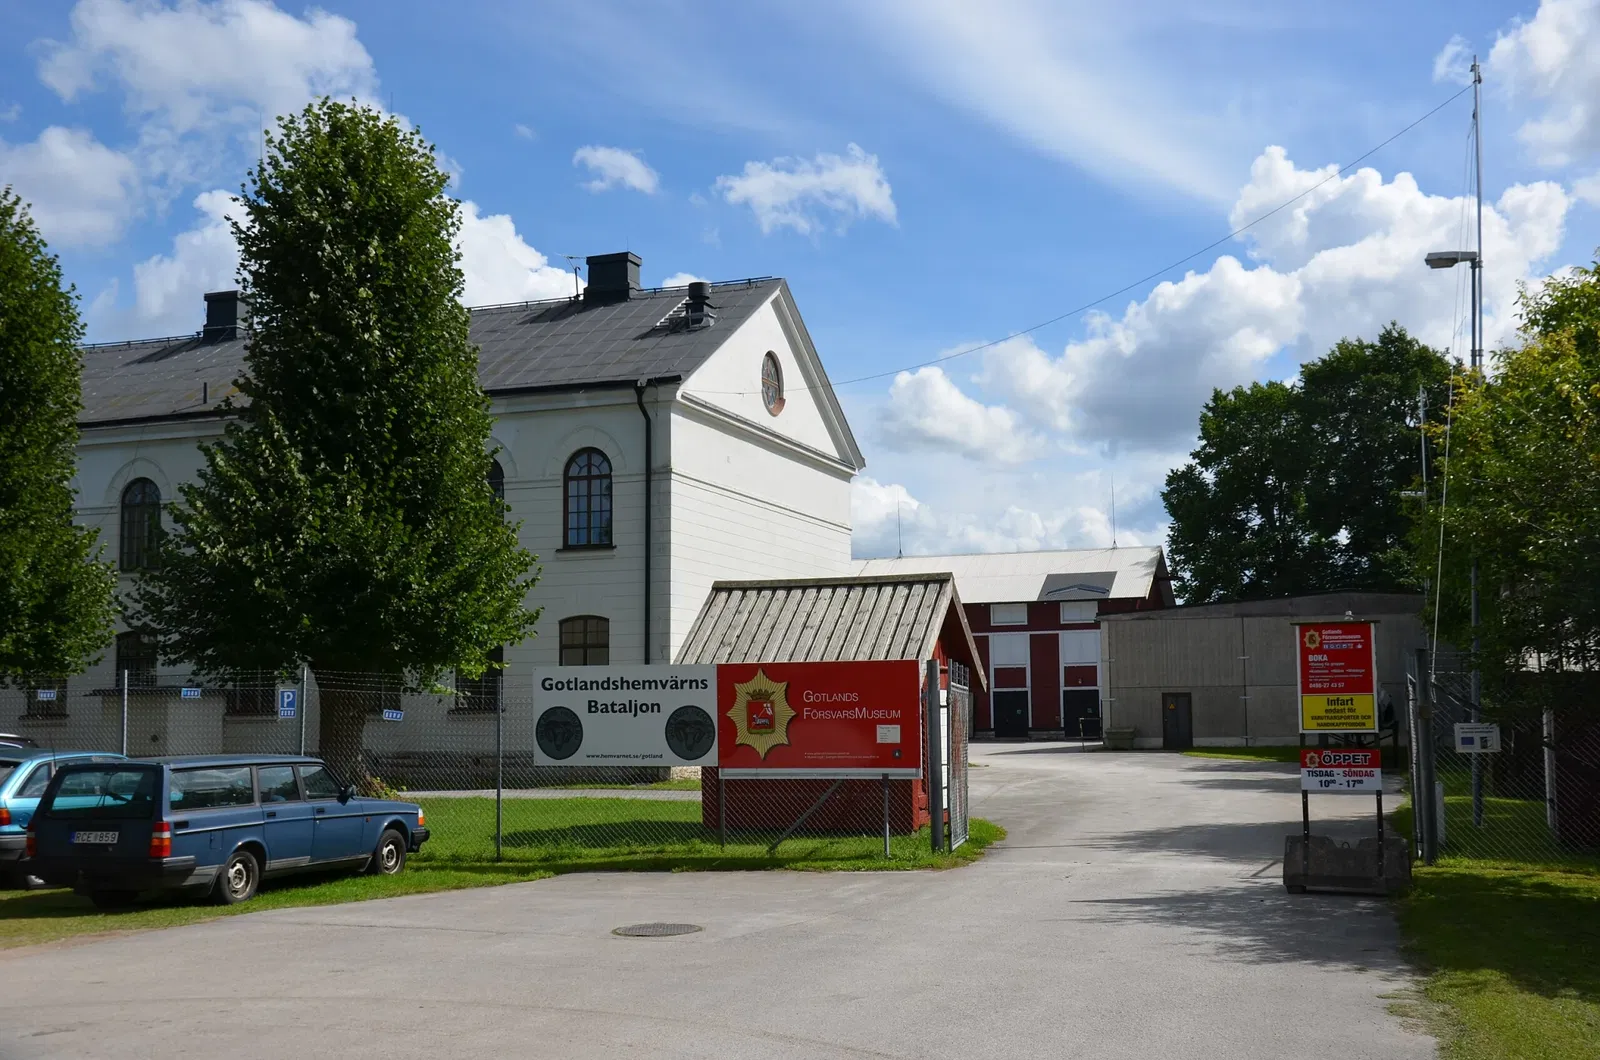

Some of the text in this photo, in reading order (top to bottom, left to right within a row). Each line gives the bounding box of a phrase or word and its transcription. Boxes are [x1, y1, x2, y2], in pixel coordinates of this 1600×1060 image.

[541, 676, 708, 691] Gotlandshemvärns
[284, 692, 294, 708] P
[1326, 697, 1354, 706] Infart
[587, 700, 661, 717] Bataljon
[1322, 750, 1371, 765] ÖPPET
[1342, 769, 1375, 777] SÖNDAG
[75, 832, 117, 842] RCE 859
